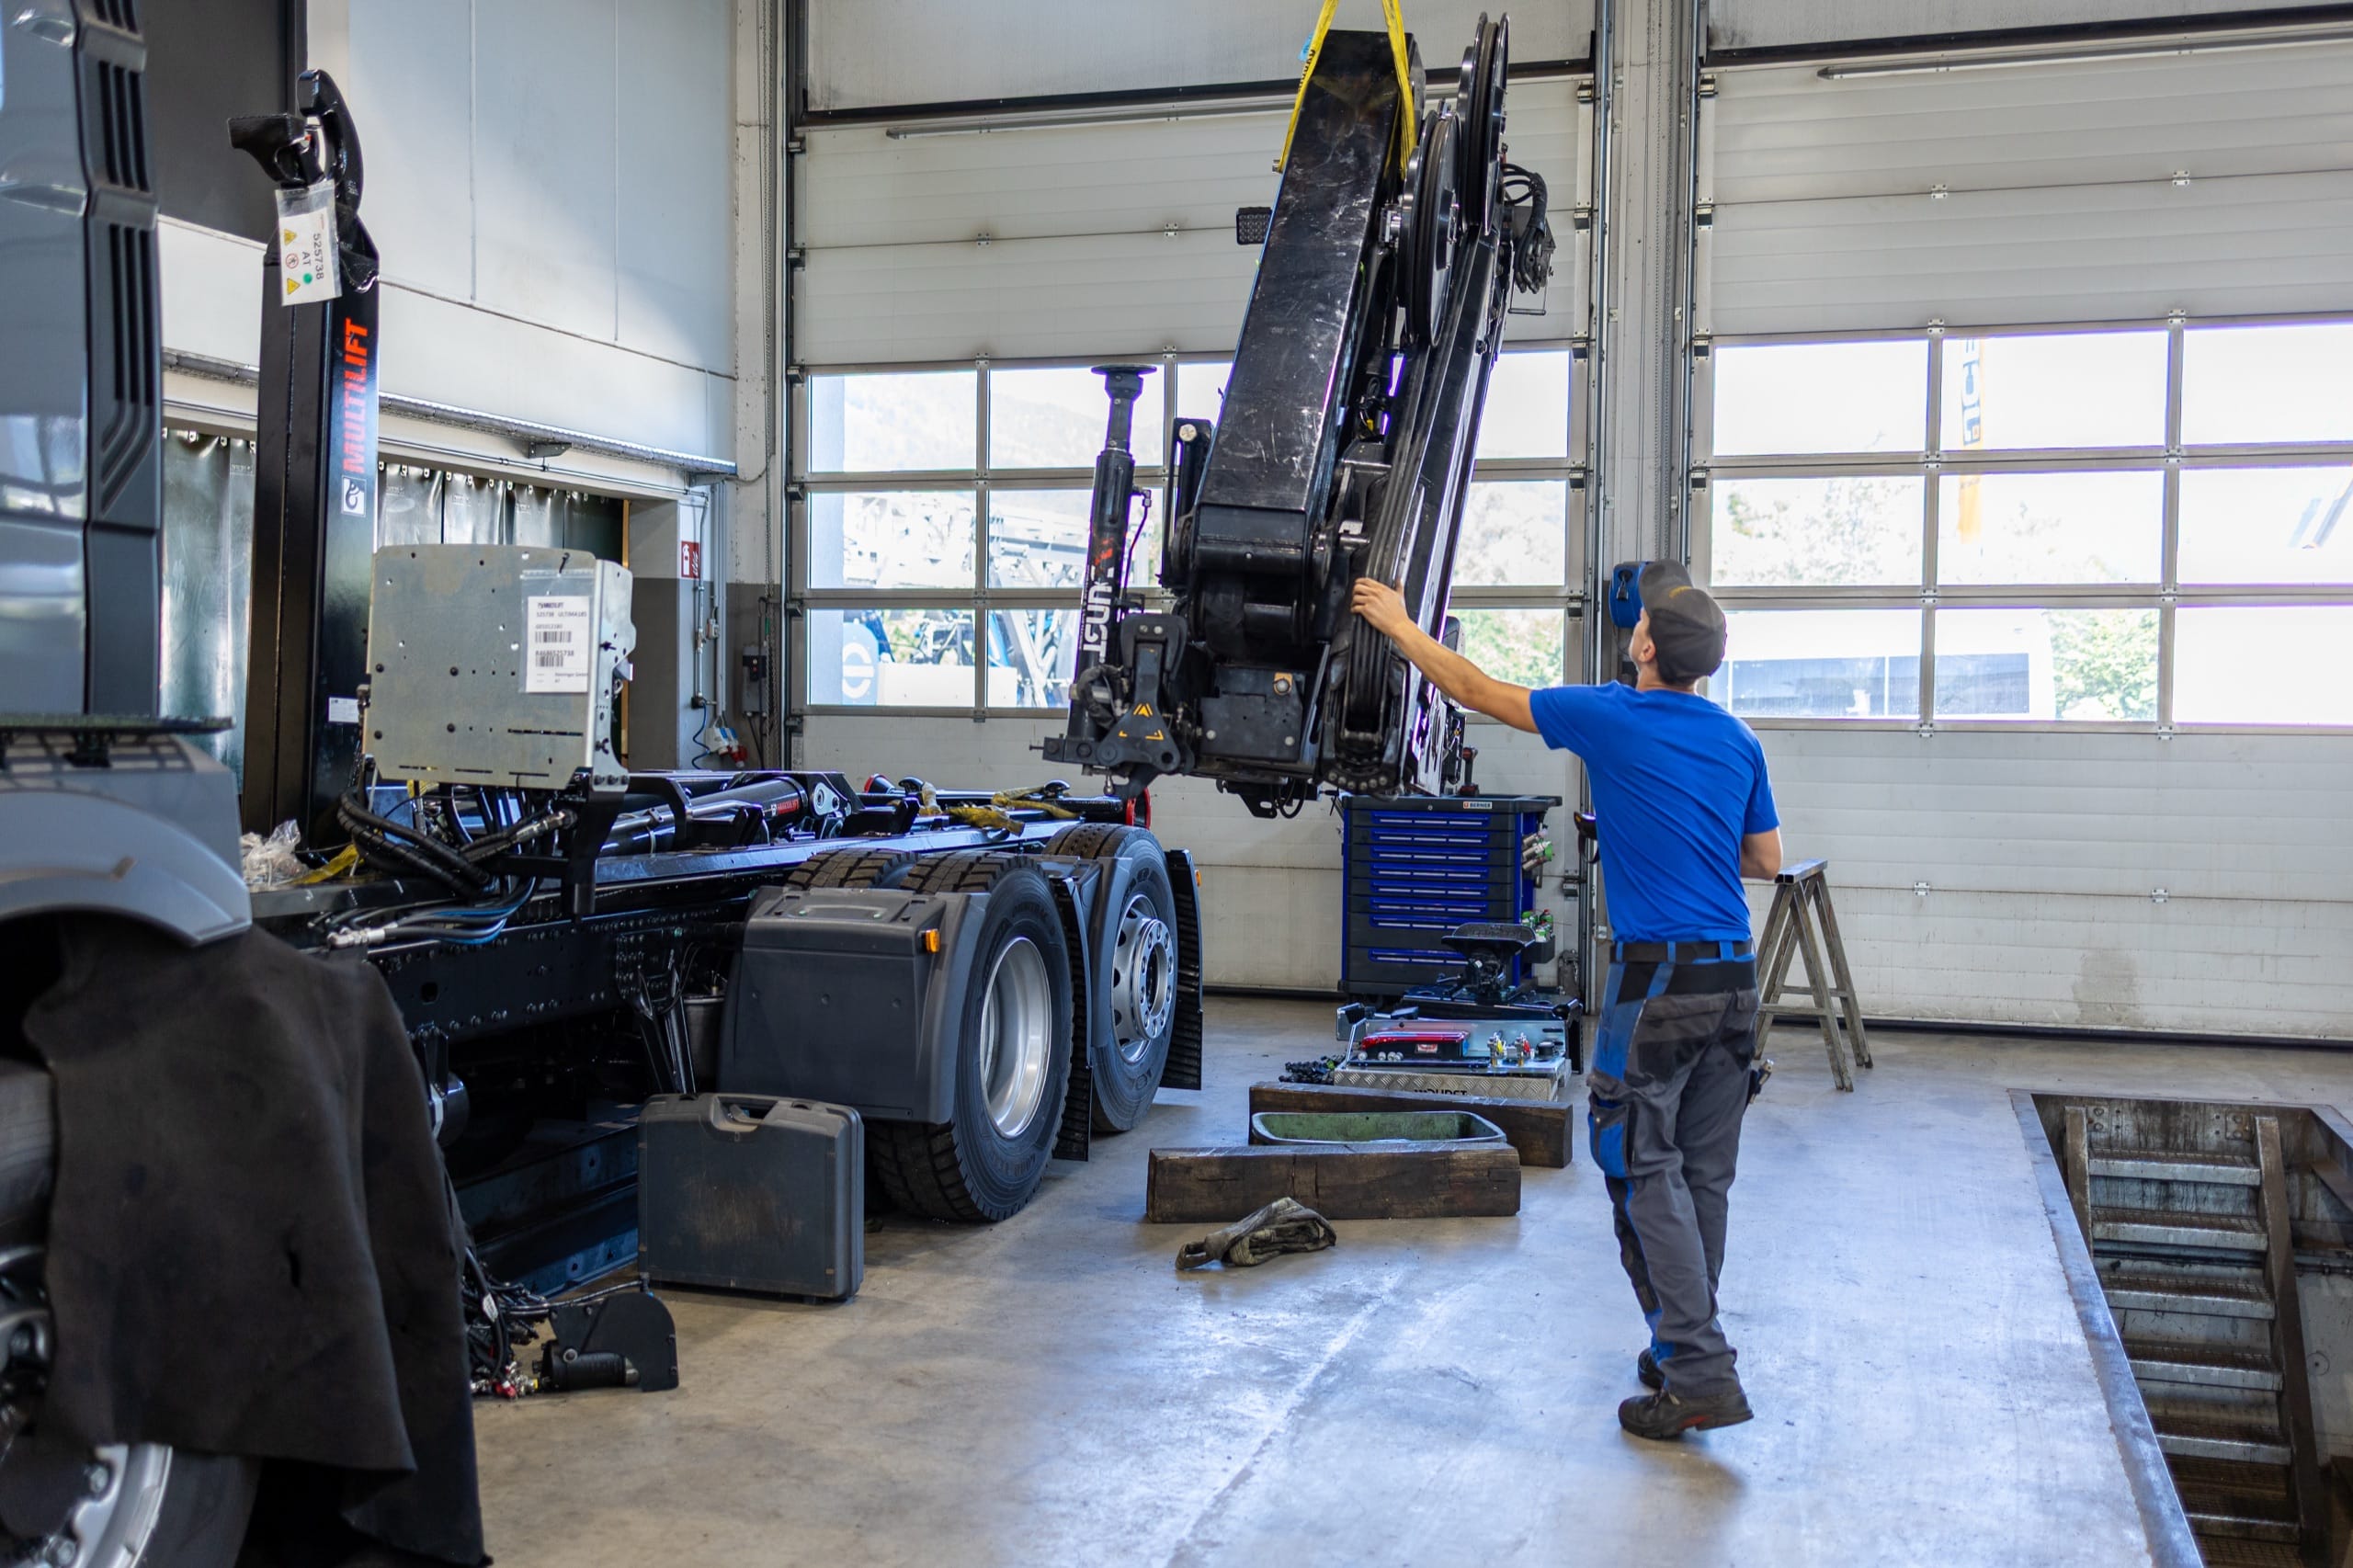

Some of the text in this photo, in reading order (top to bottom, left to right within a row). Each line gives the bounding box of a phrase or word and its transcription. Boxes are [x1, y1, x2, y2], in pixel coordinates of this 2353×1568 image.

[301, 251, 312, 266] AT
[313, 233, 324, 280] 525738
[343, 317, 369, 473] MULTILIFT
